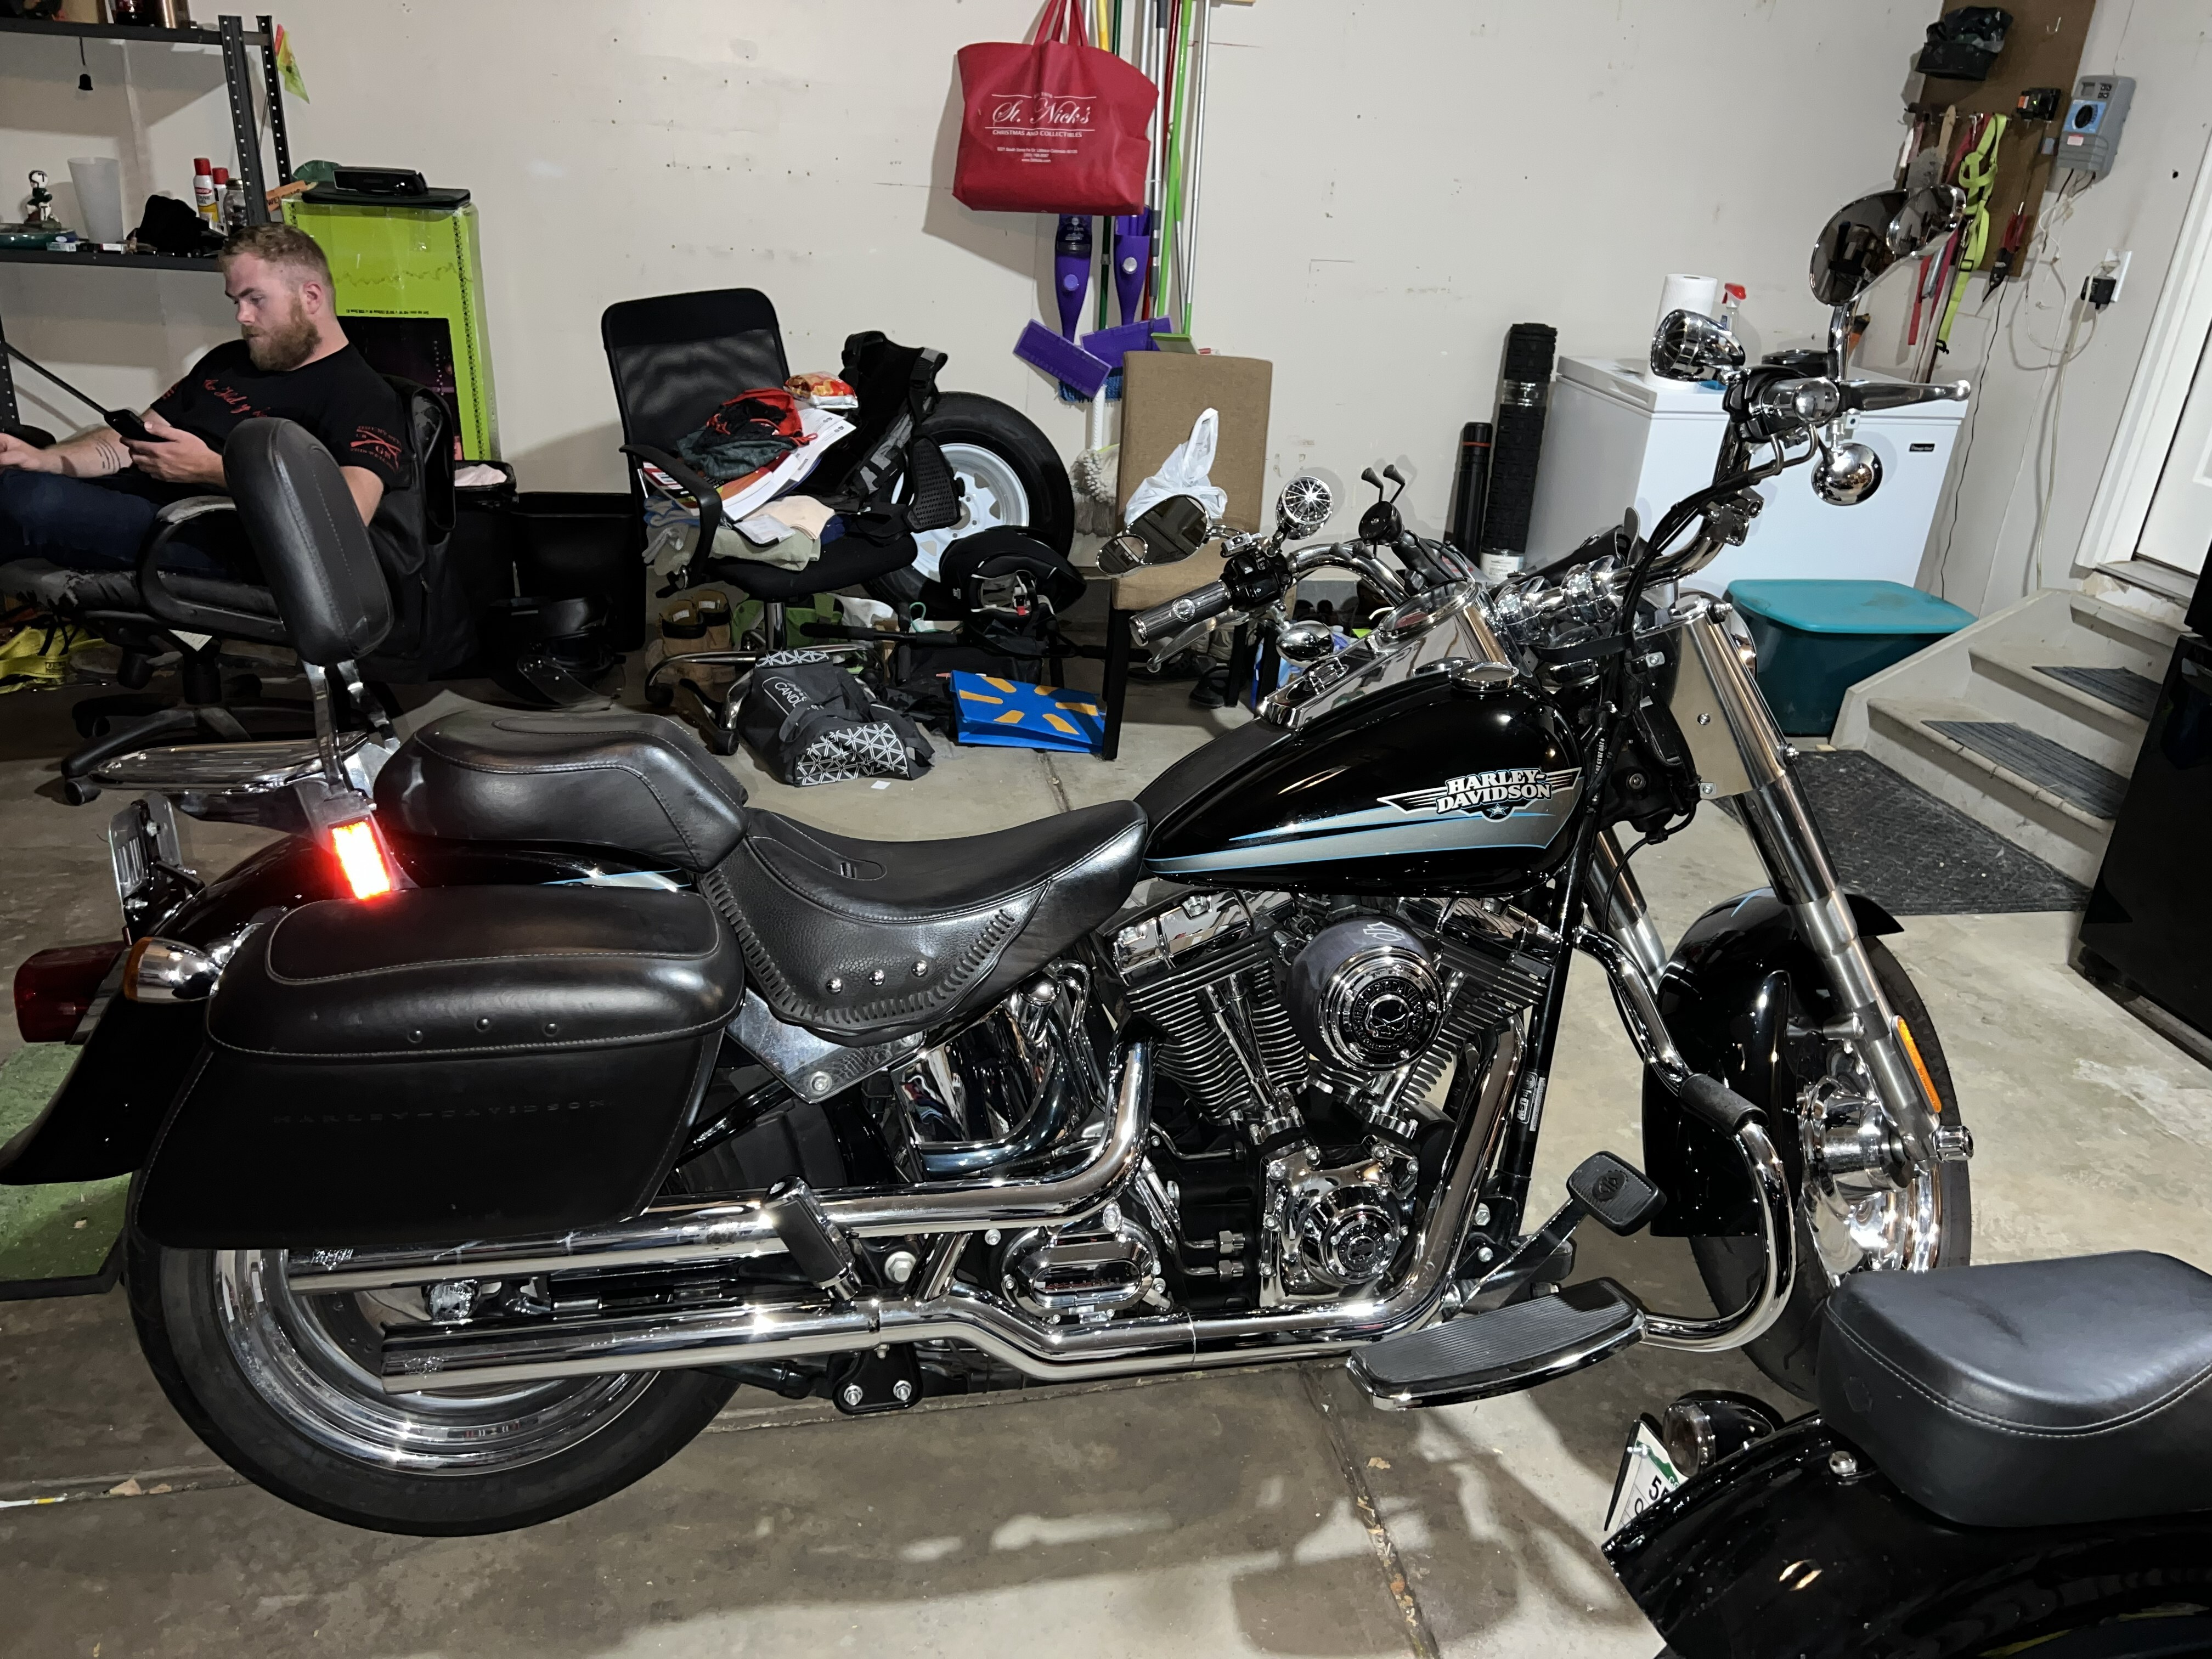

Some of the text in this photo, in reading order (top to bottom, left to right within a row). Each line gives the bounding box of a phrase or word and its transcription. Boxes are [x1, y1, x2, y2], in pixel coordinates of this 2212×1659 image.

[992, 98, 1091, 127] St. Nick's
[1447, 769, 1546, 794] HARLEY-
[1436, 783, 1551, 814] DAVIDSON
